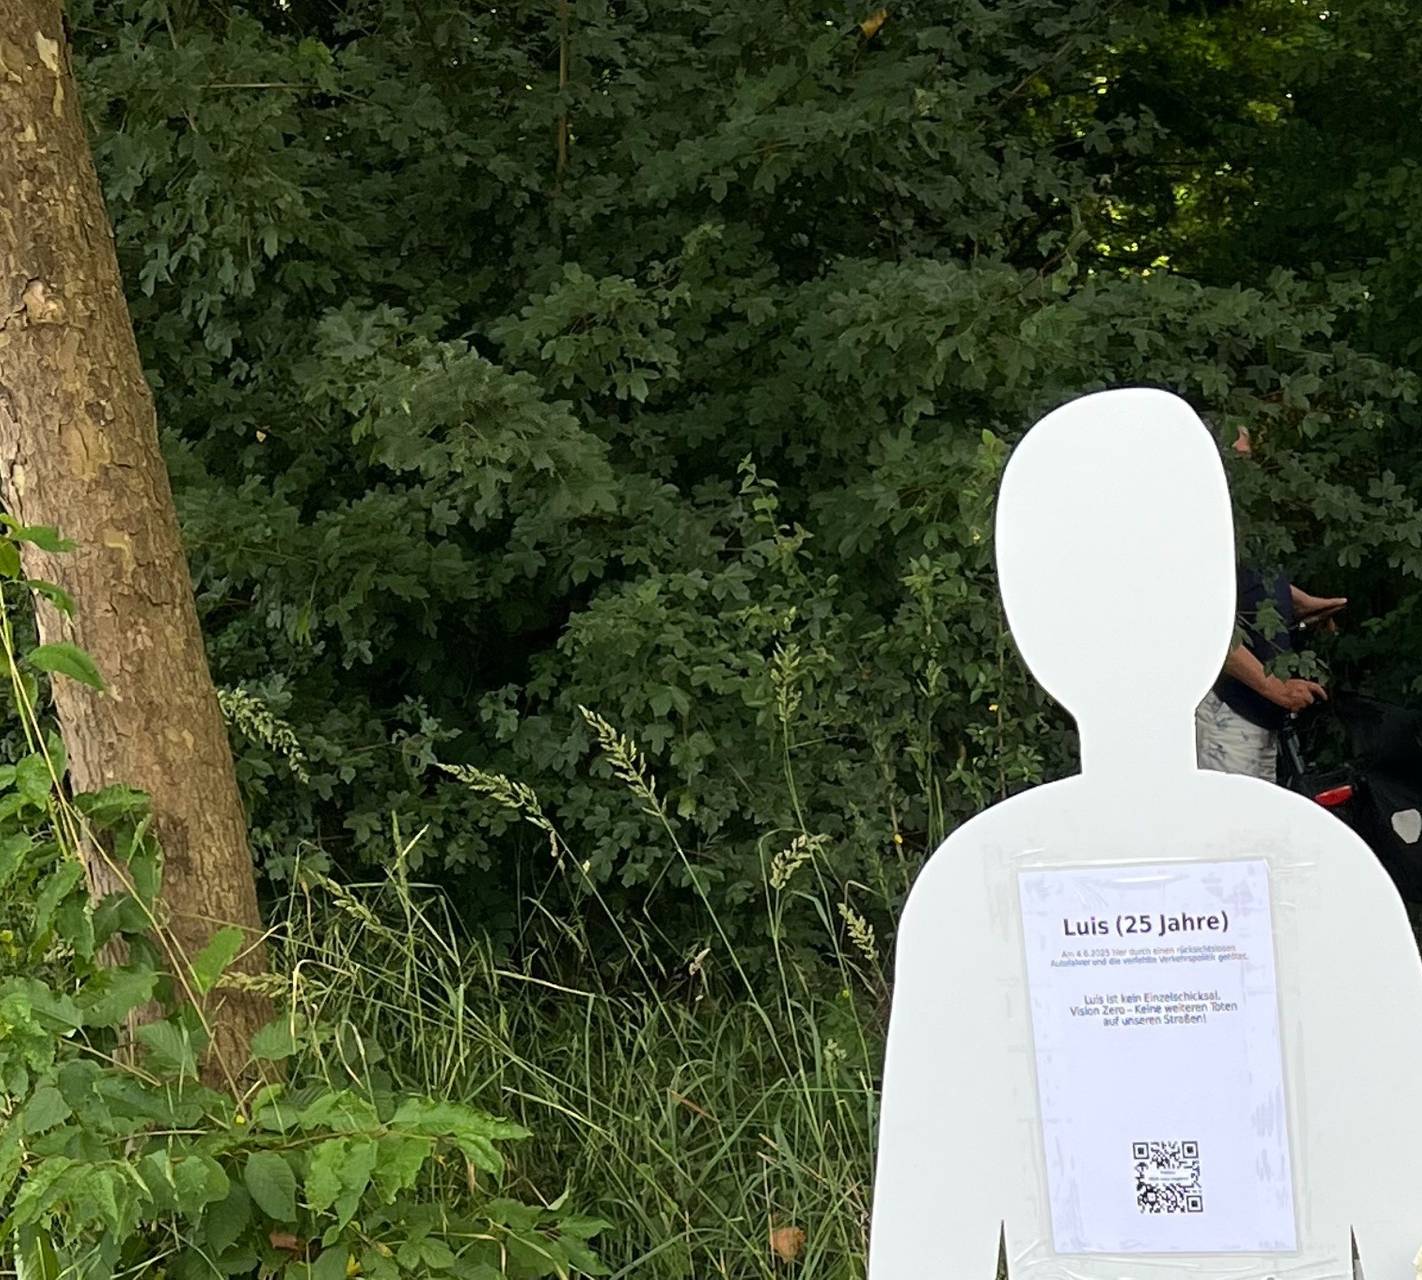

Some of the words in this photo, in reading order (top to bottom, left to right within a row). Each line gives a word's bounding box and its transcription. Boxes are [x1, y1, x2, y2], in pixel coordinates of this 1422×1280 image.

[1063, 916, 1109, 936] Luis
[1116, 914, 1152, 937] (25
[1158, 911, 1229, 936] Jahre)
[1084, 995, 1104, 1006] Luis
[1106, 994, 1119, 1004] ist
[1121, 992, 1142, 1004] kein
[1070, 1006, 1100, 1017] Vision
[1102, 1004, 1126, 1016] Zero
[1135, 1003, 1162, 1014] Keine
[1164, 1002, 1208, 1013] weiteren
[1212, 1000, 1238, 1012] Toten
[1103, 1015, 1120, 1026] auf
[1122, 1014, 1162, 1026] unseren
[1164, 1012, 1207, 1025] Straßen!
